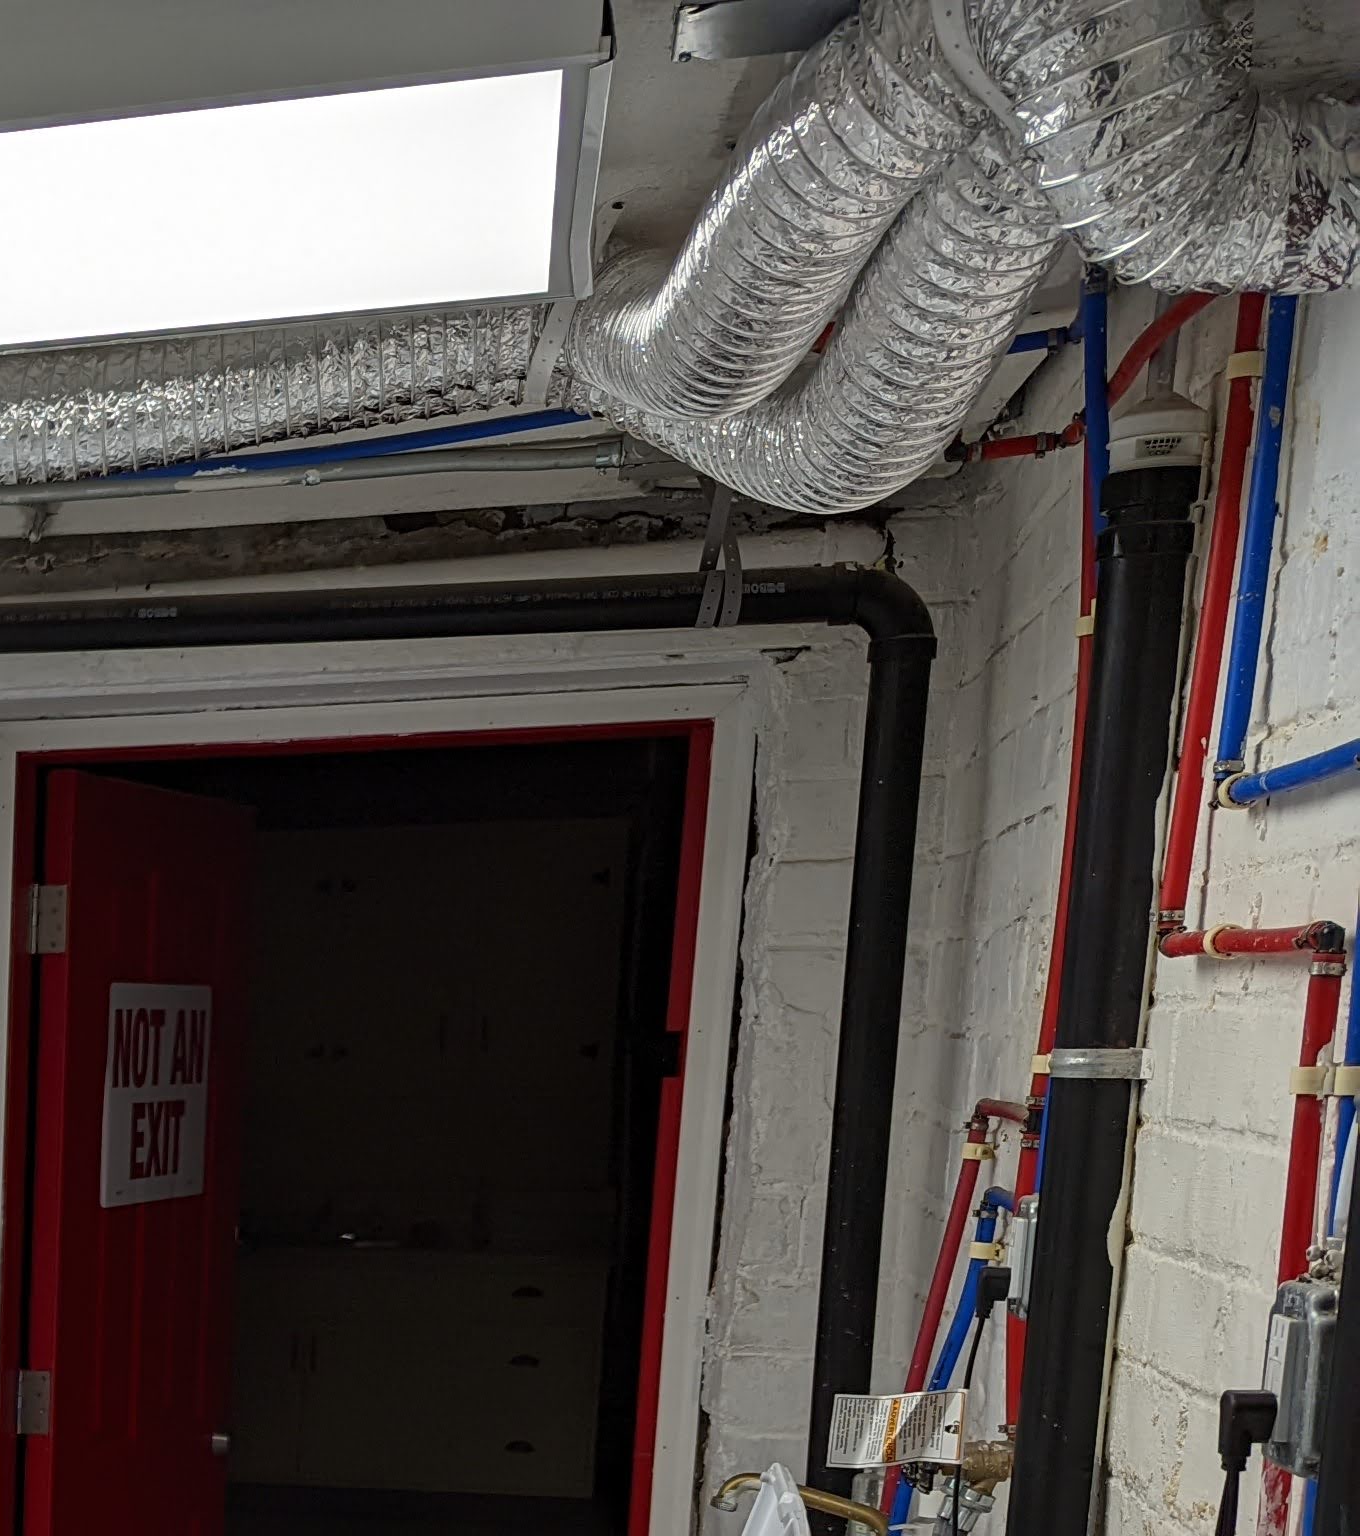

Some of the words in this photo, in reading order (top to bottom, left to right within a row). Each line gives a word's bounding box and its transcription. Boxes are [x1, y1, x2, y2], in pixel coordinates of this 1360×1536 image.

[112, 1008, 166, 1088] NOT
[170, 1009, 206, 1086] AN
[129, 1099, 187, 1180] EXIT
